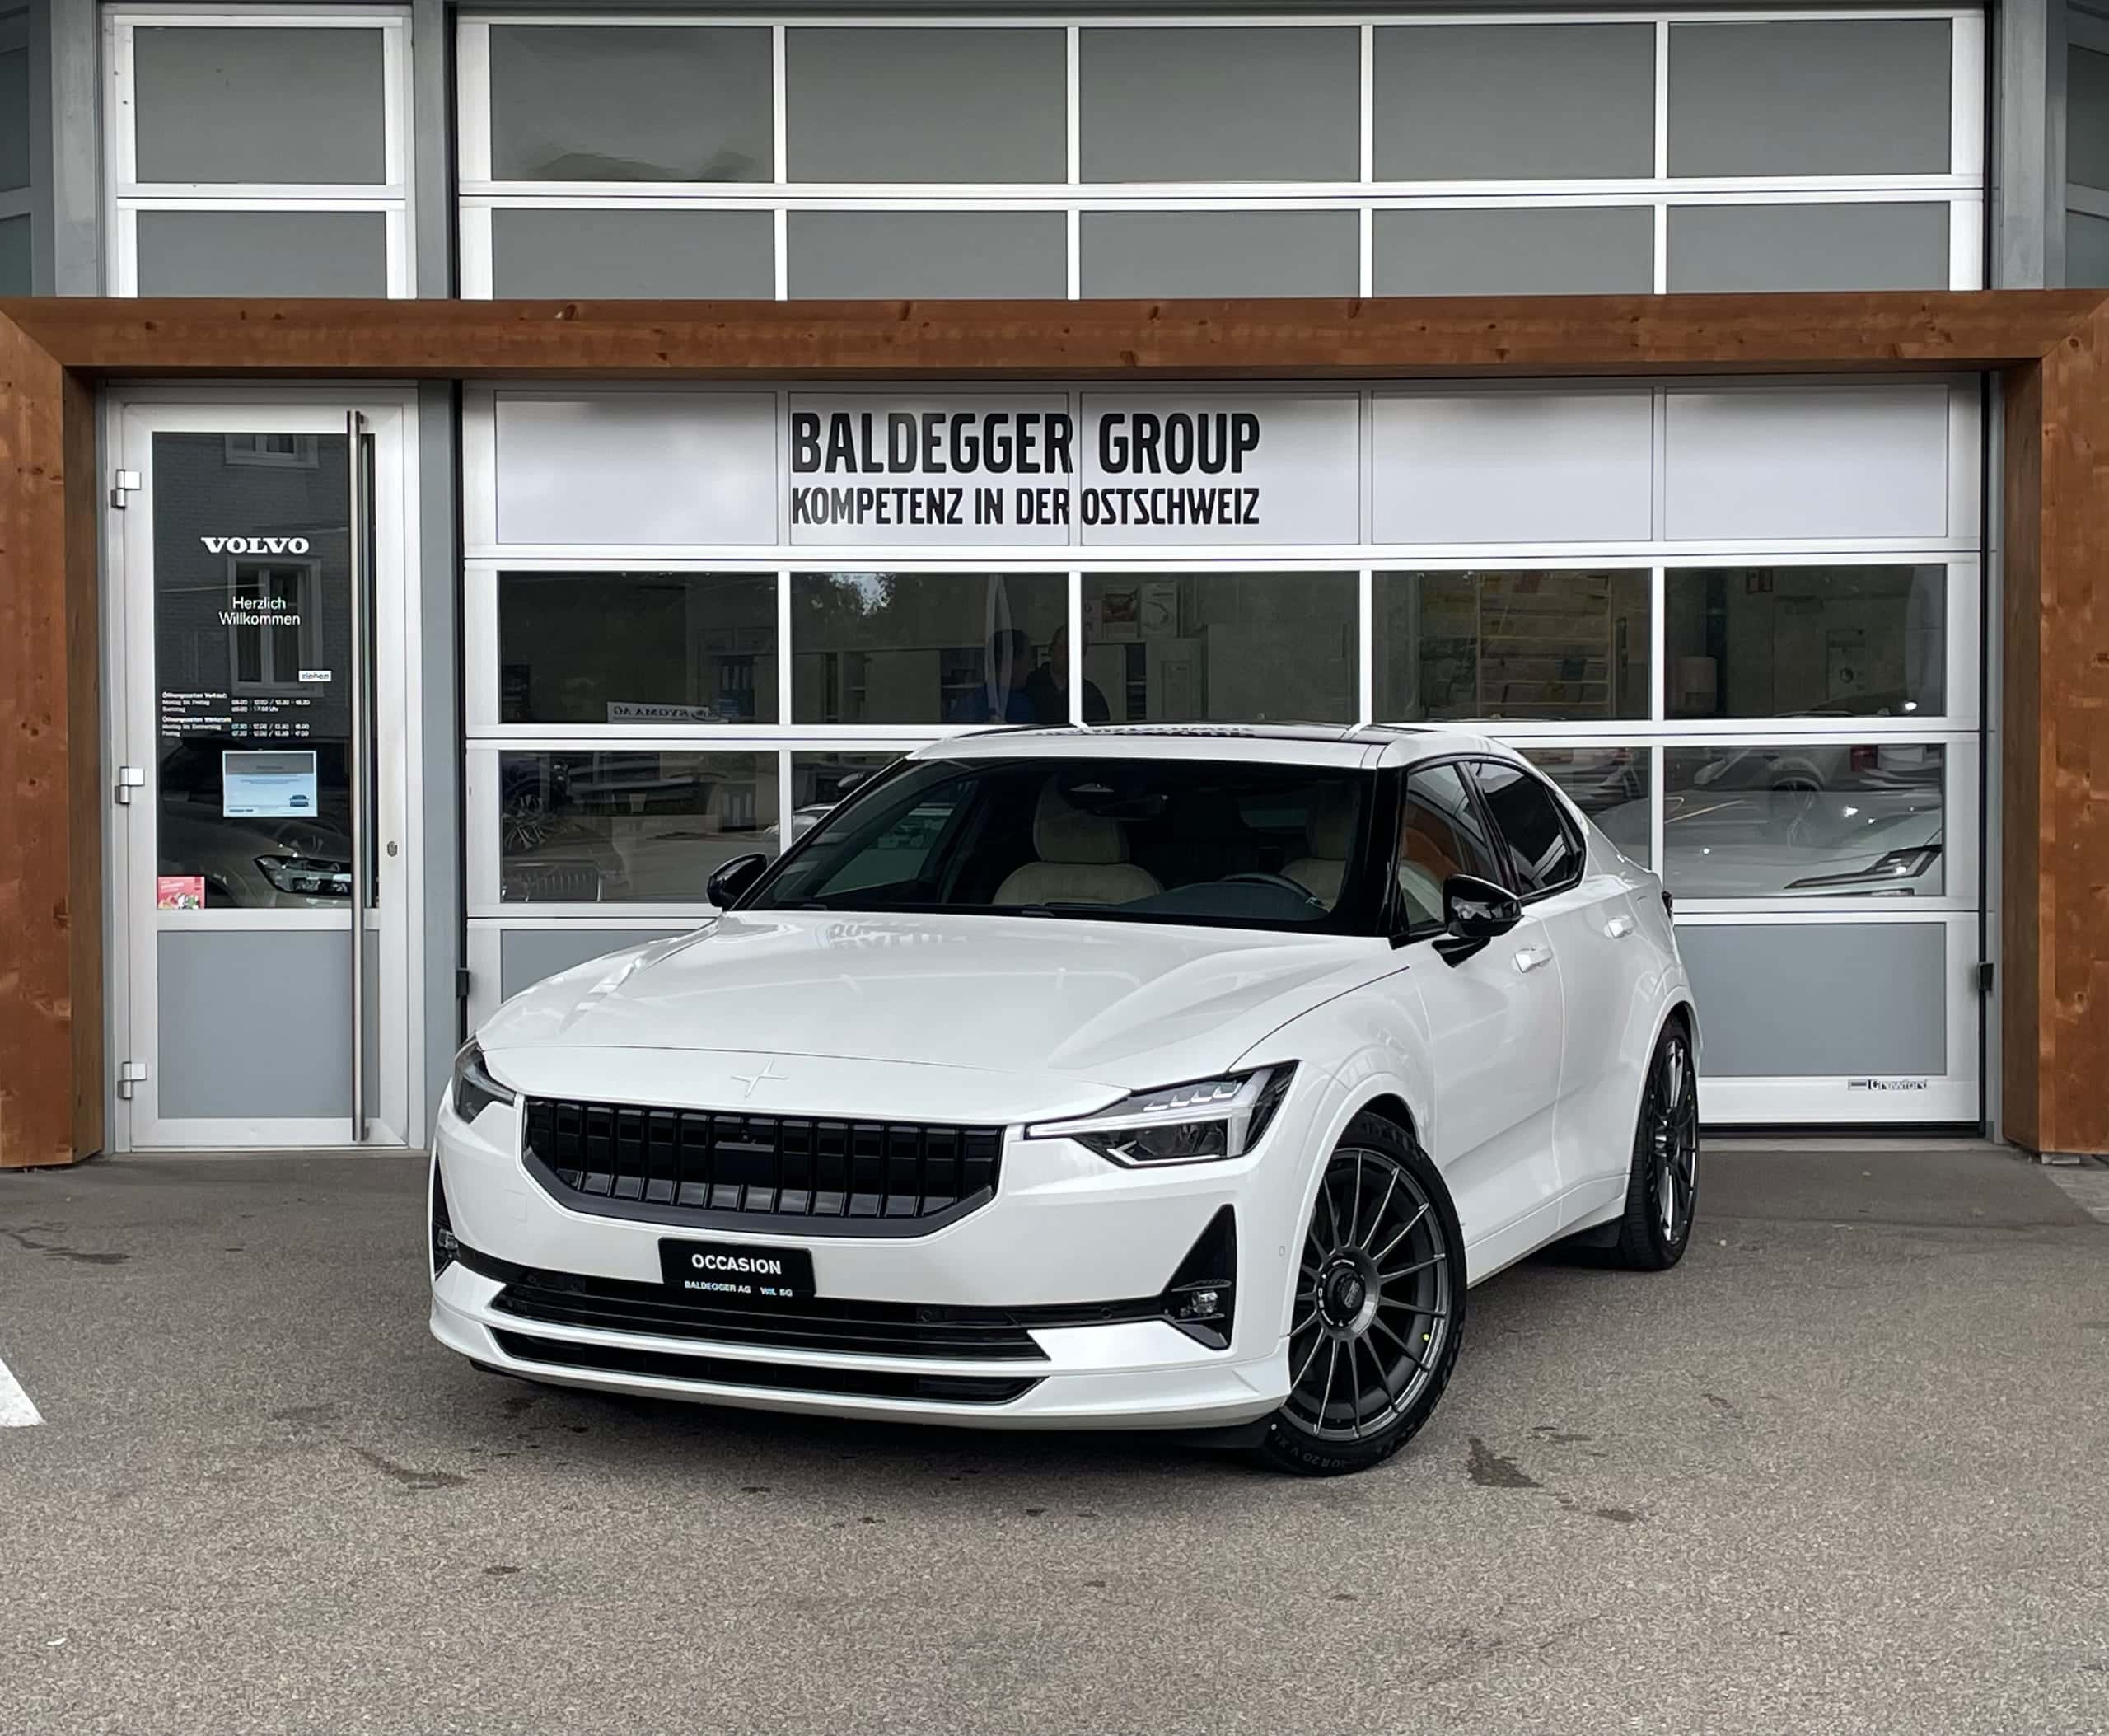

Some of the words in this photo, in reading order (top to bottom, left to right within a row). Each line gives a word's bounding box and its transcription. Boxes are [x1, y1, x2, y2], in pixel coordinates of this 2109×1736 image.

[791, 412, 1073, 474] BALDEGGER
[1098, 412, 1260, 474] GROUP
[792, 487, 963, 526] KOMPETENZ
[974, 487, 1003, 525] IN
[1016, 487, 1069, 525] DER
[1081, 487, 1260, 526] OSTSCHWEIZ
[200, 536, 310, 554] VOLVO
[232, 596, 287, 610] Herzlich
[218, 611, 301, 625] Willkommen
[691, 1253, 782, 1275] OCCASION
[684, 1280, 737, 1293] BALDEGGER
[737, 1285, 751, 1294] AG
